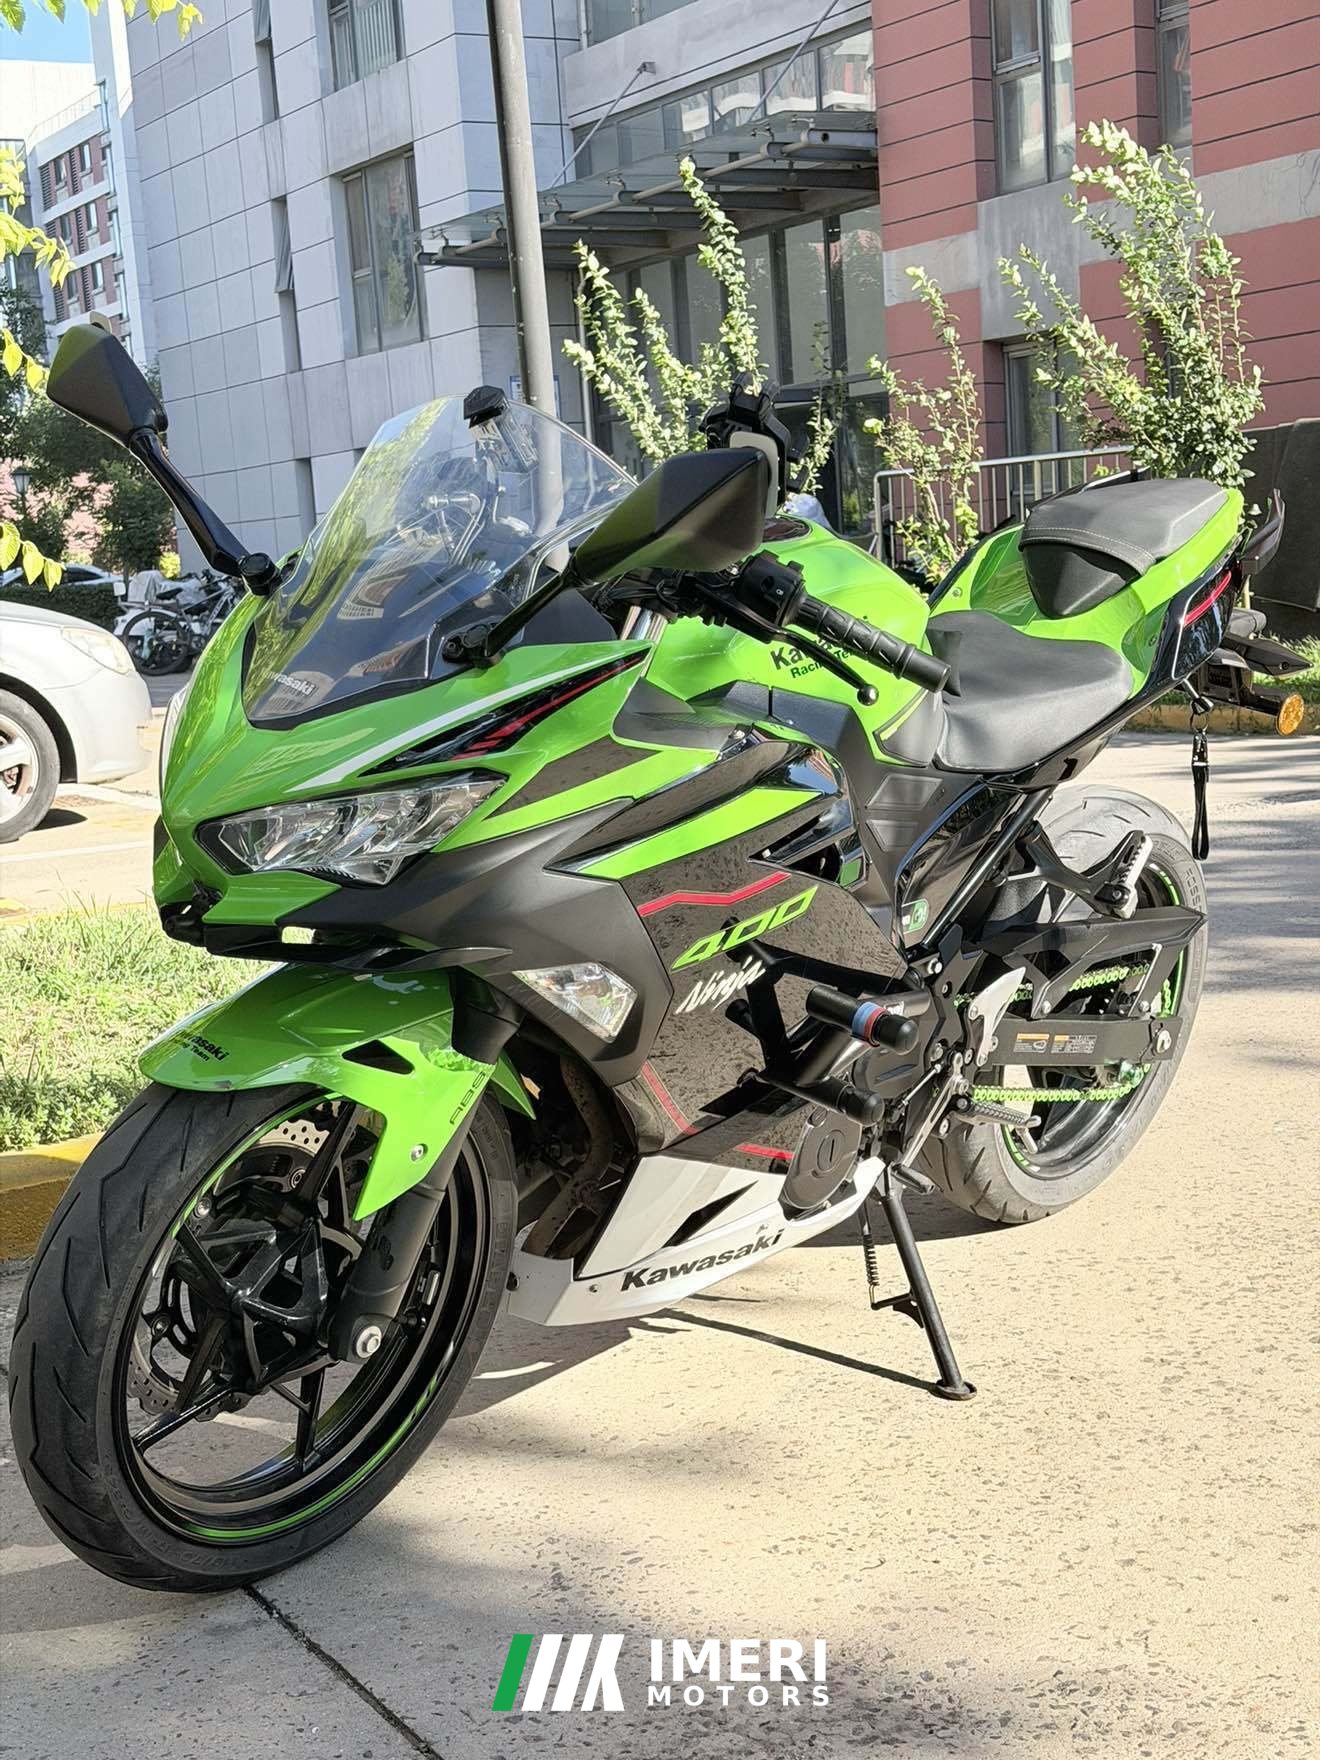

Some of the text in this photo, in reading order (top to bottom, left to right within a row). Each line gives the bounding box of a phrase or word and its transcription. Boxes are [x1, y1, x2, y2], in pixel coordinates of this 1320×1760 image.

[671, 884, 818, 970] 400
[674, 955, 767, 1014] Ninja
[620, 1228, 785, 1292] Kawasaki
